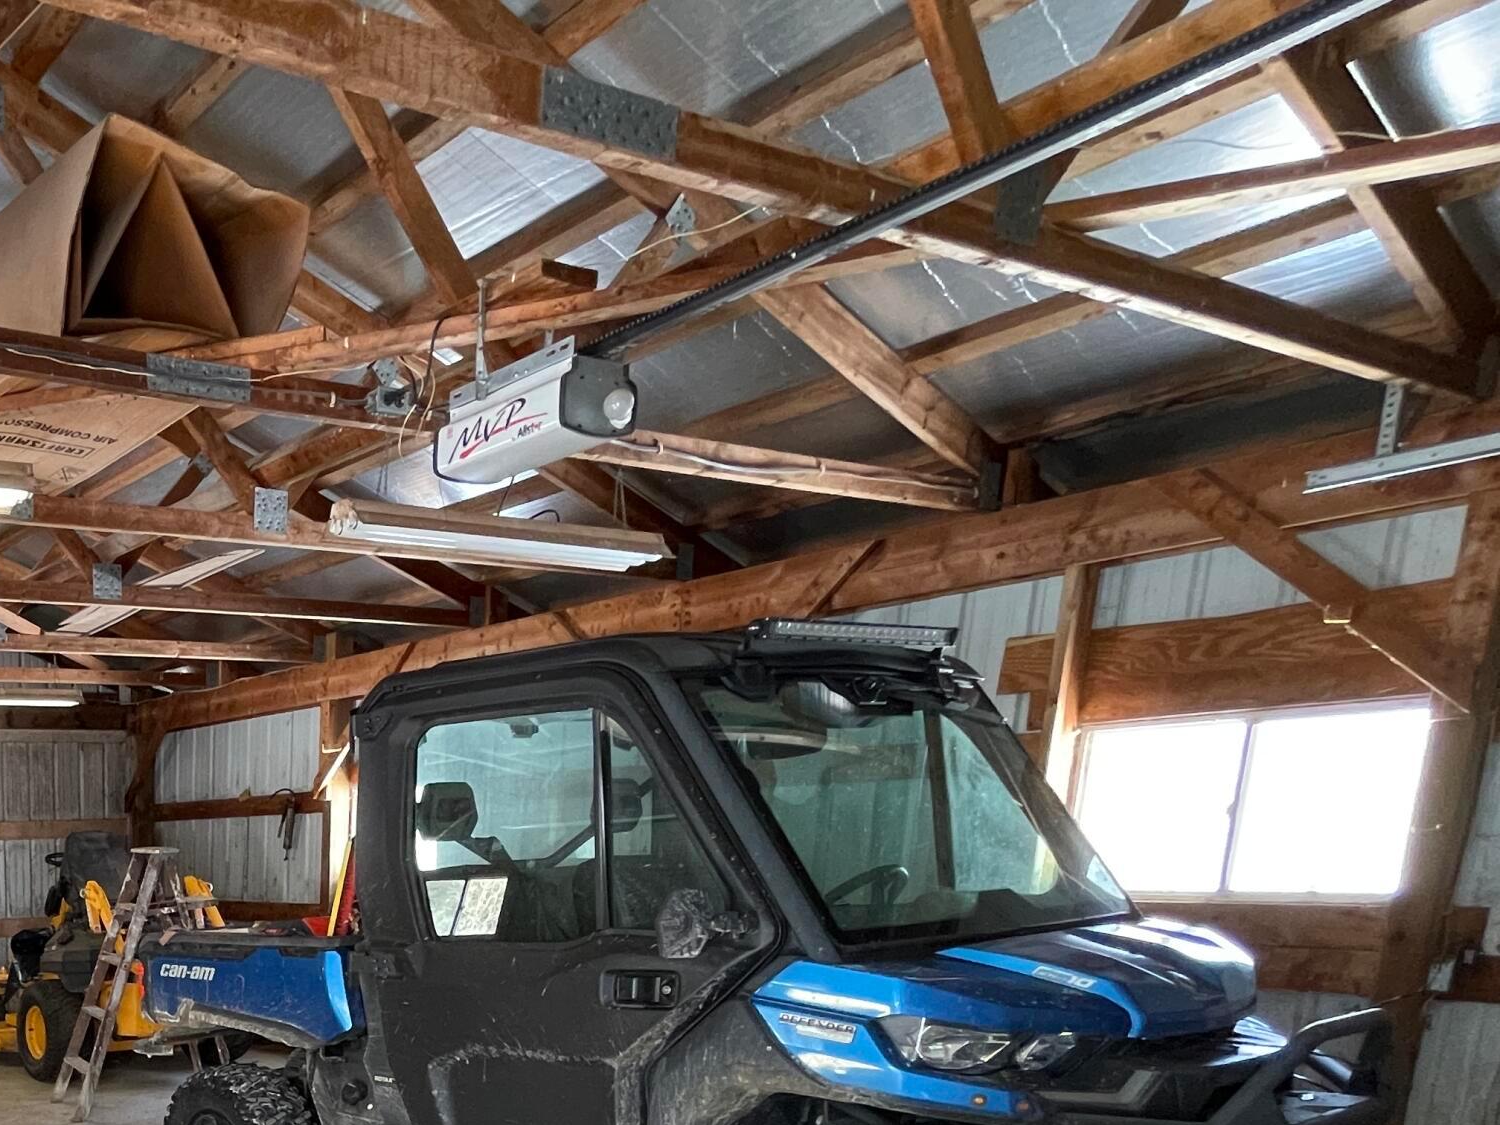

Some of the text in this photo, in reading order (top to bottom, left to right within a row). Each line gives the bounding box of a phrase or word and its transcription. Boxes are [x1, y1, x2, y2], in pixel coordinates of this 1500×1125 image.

[93, 434, 119, 445] AIR
[448, 398, 526, 464] MVP
[160, 963, 216, 981] can-am
[781, 1014, 854, 1033] DEFENDER
